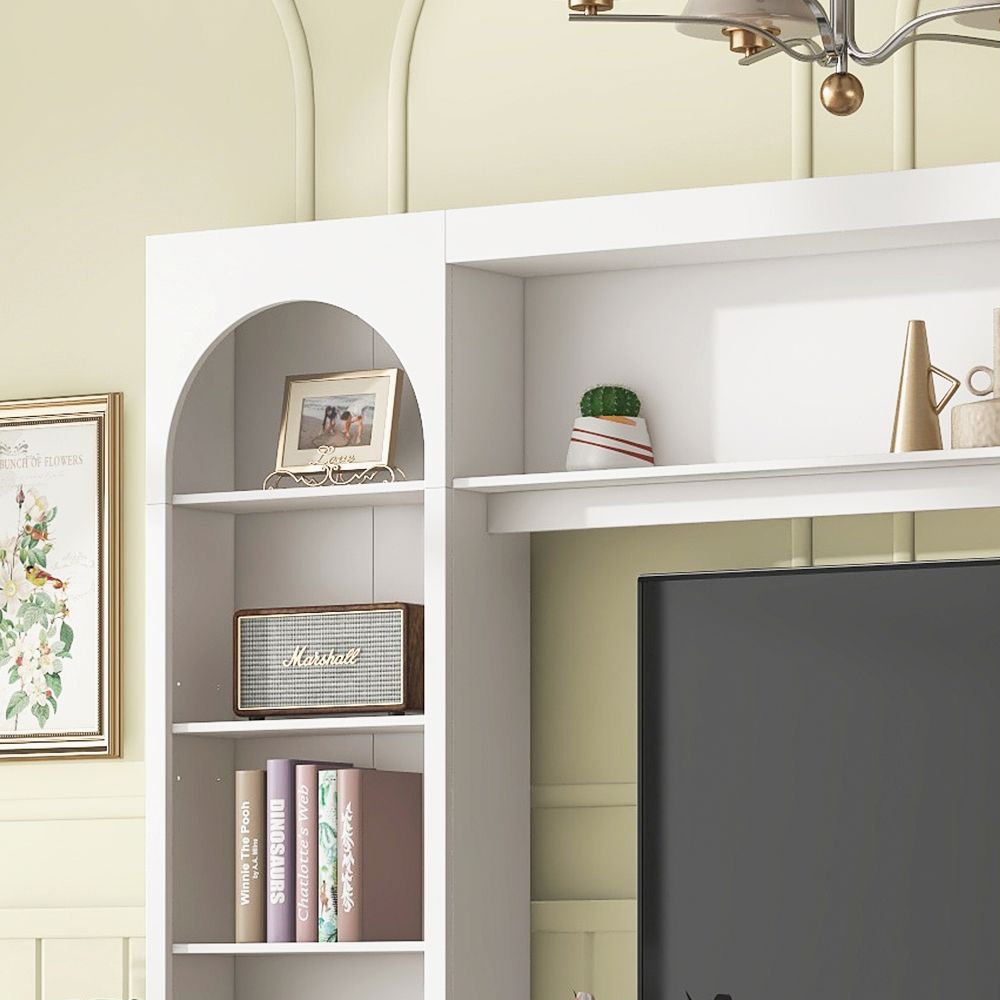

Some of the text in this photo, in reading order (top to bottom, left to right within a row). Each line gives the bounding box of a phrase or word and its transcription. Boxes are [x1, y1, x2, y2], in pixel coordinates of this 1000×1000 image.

[44, 454, 84, 468] FLOWERS
[282, 644, 361, 668] Marshall
[298, 784, 310, 822] Web
[240, 800, 250, 905] Winnie The Pooh
[270, 798, 285, 904] DINOSAURS
